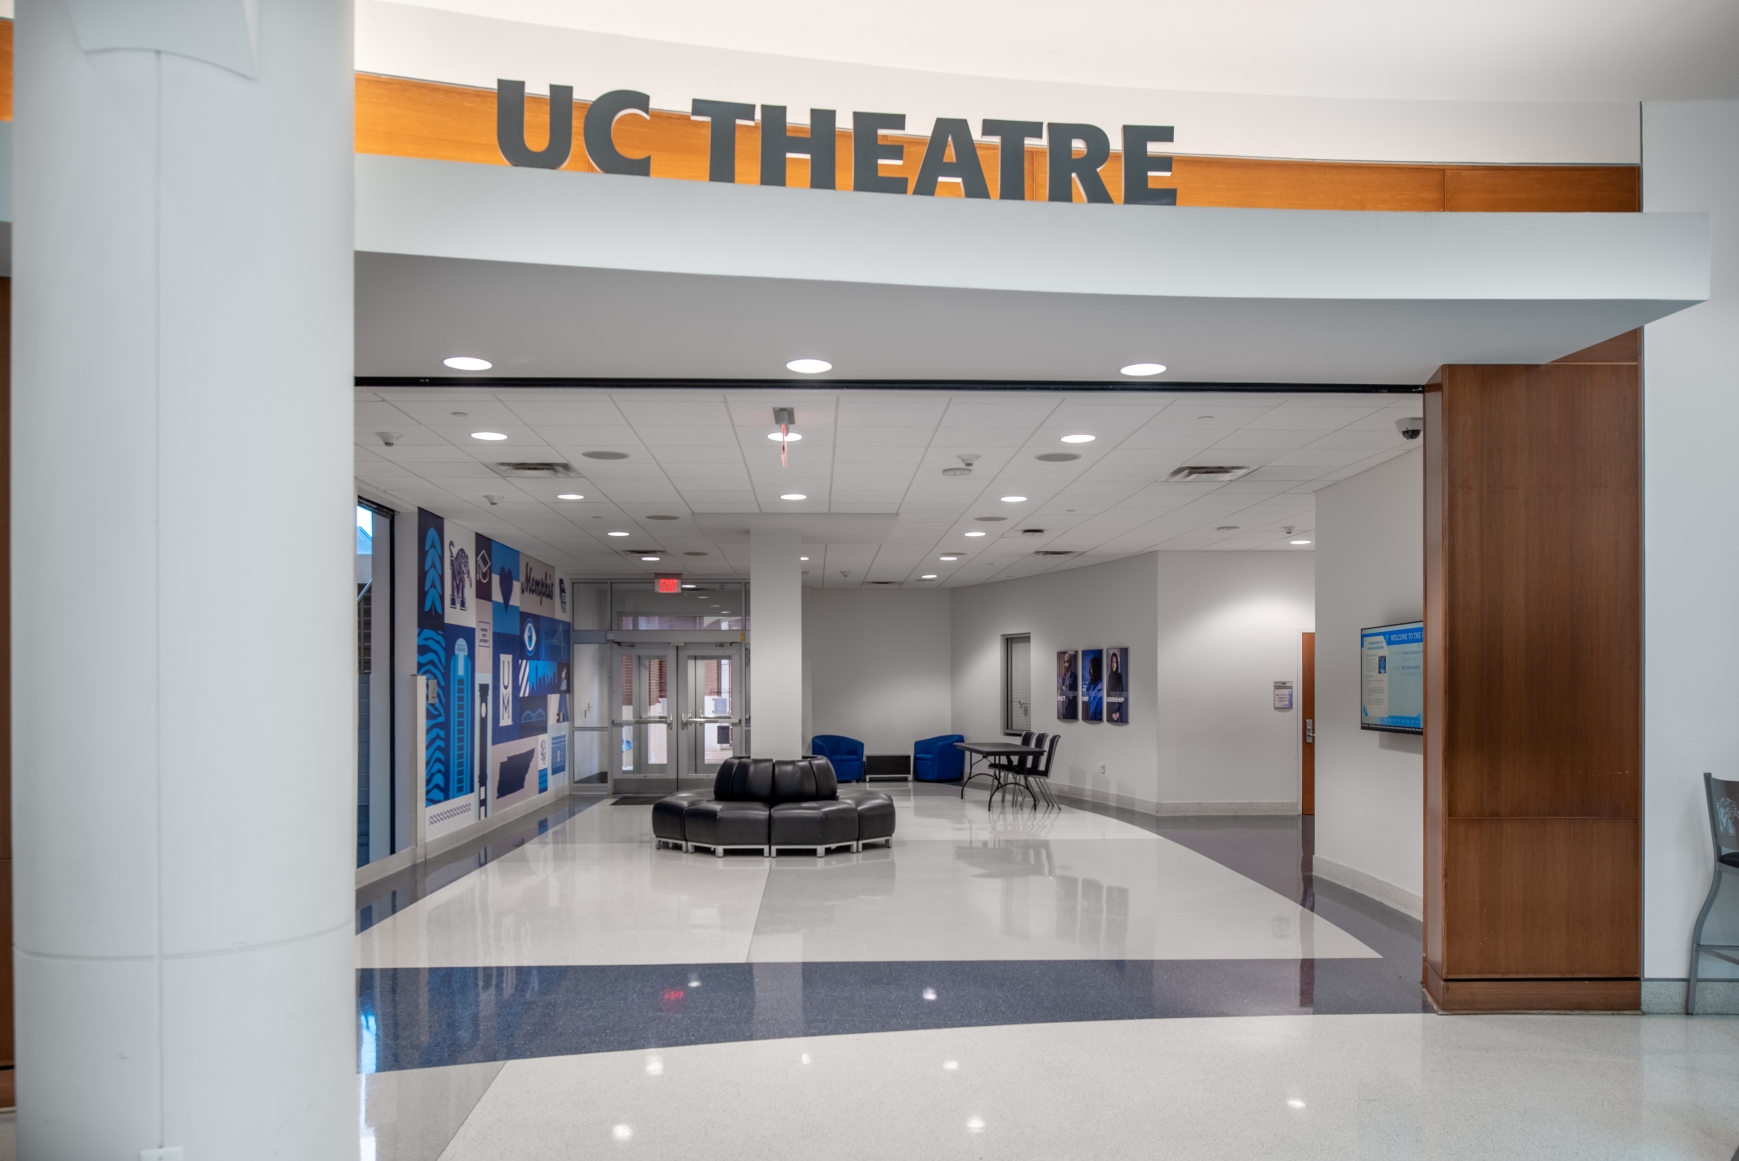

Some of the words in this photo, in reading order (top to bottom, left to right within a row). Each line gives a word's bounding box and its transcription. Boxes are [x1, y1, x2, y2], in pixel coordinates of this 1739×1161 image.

[496, 79, 651, 177] UC
[691, 98, 1178, 206] THEATRE
[521, 562, 554, 606] Memphis
[660, 579, 677, 592] EXIT
